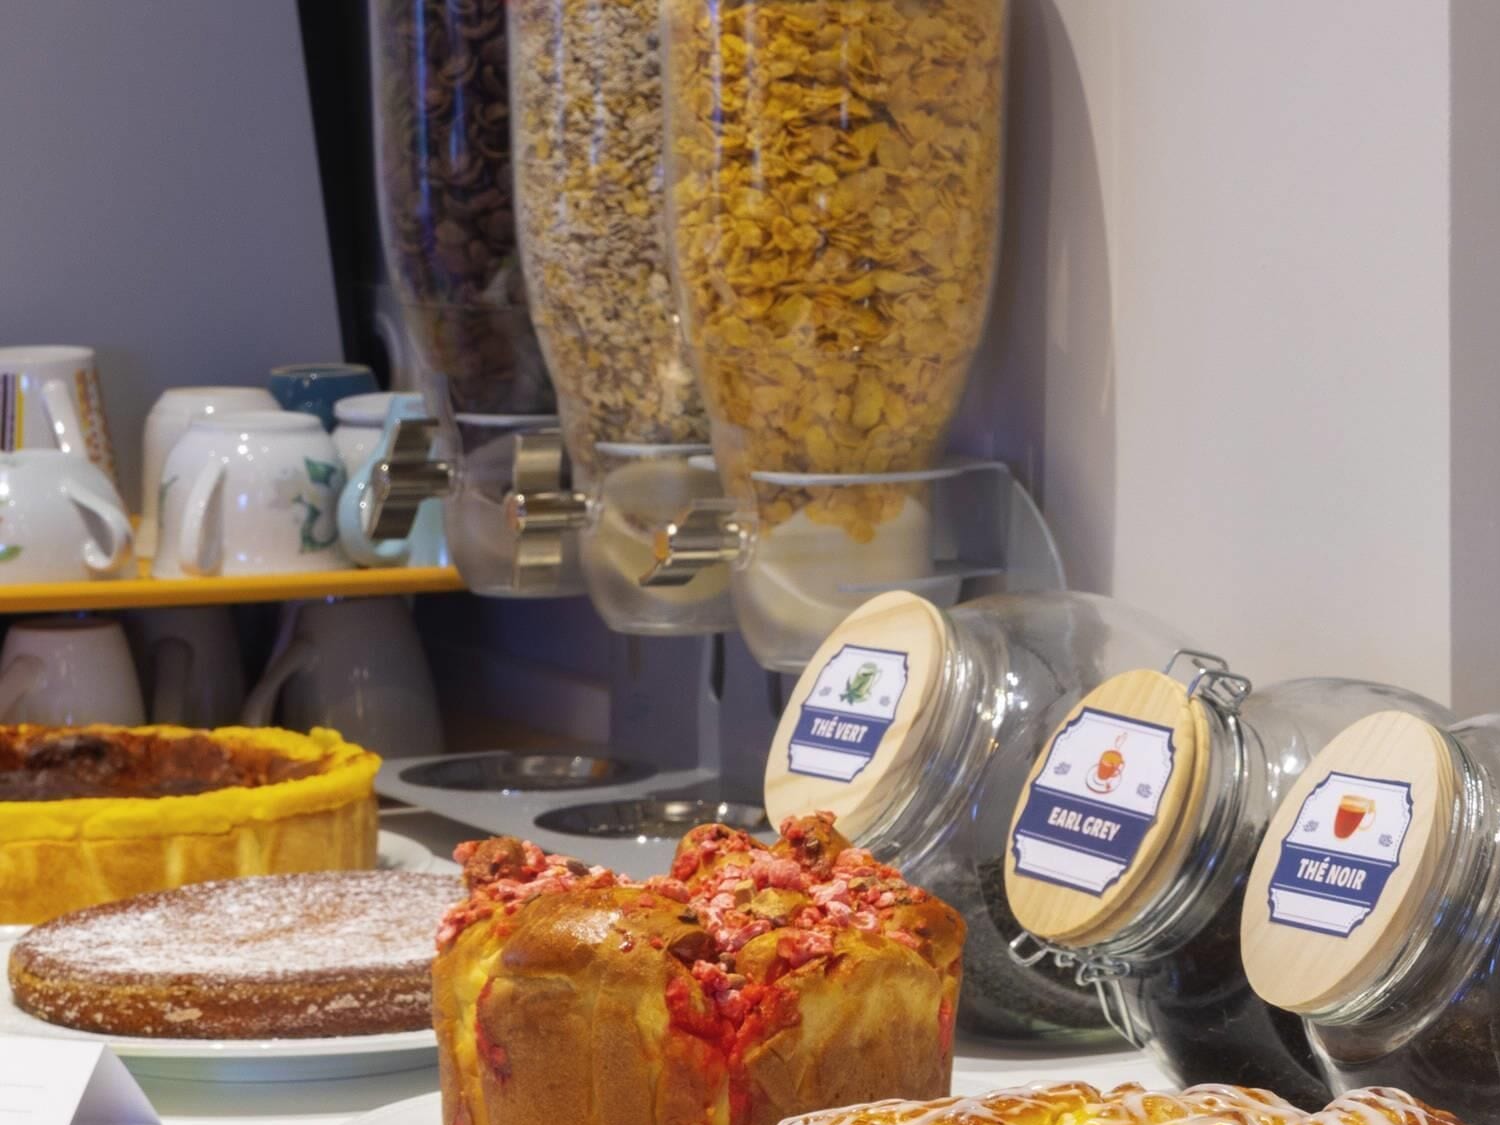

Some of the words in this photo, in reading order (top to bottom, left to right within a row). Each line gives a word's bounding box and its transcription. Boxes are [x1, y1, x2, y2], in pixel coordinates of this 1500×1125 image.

[810, 715, 835, 738] THÉ
[836, 720, 868, 743] VERT
[1047, 806, 1083, 833] EARL
[1083, 815, 1121, 843] GREY
[1296, 857, 1327, 886] THÉ
[1327, 865, 1367, 891] NOIR
